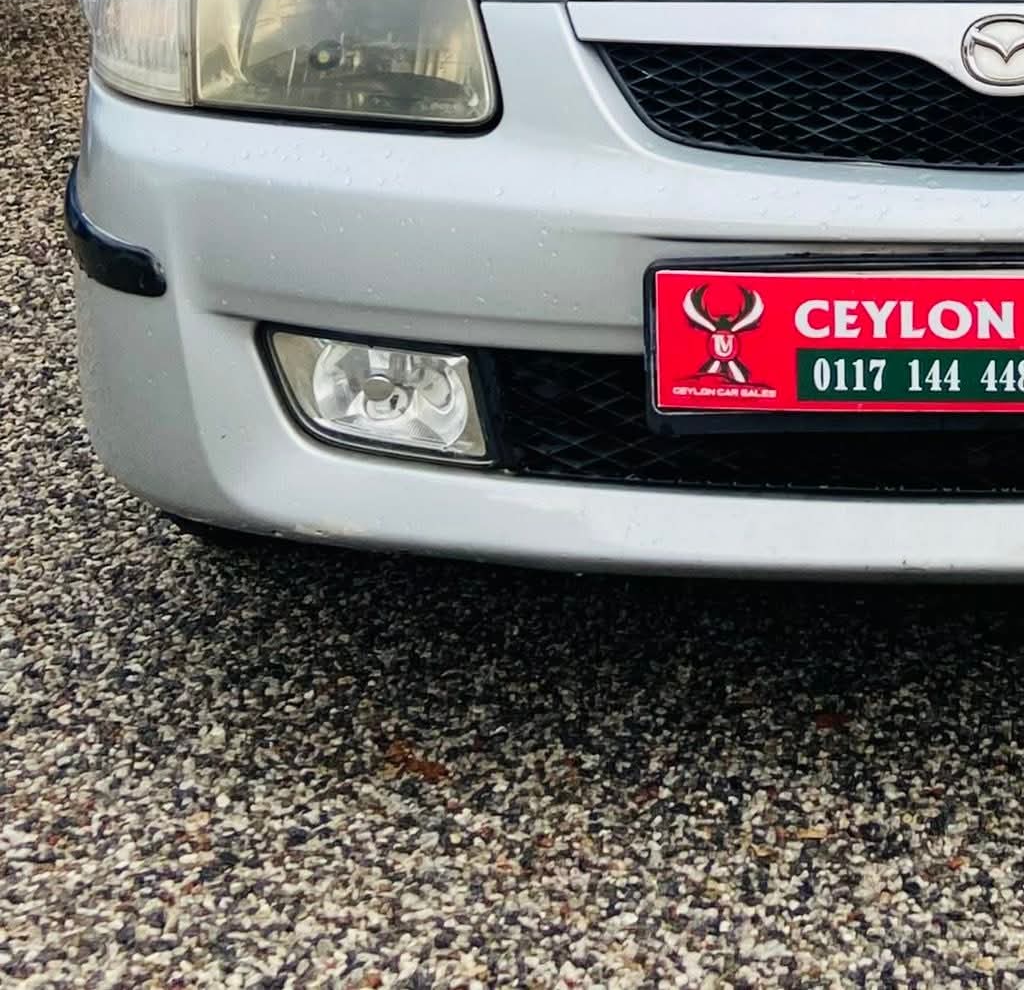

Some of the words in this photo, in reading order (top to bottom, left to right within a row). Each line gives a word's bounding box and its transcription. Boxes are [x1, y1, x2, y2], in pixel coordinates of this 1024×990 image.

[795, 299, 1015, 339] CEYLON
[672, 386, 716, 396] CEYLON
[716, 388, 739, 397] CAR
[740, 388, 777, 398] SALES
[813, 357, 886, 392] 0117
[908, 359, 960, 392] 144
